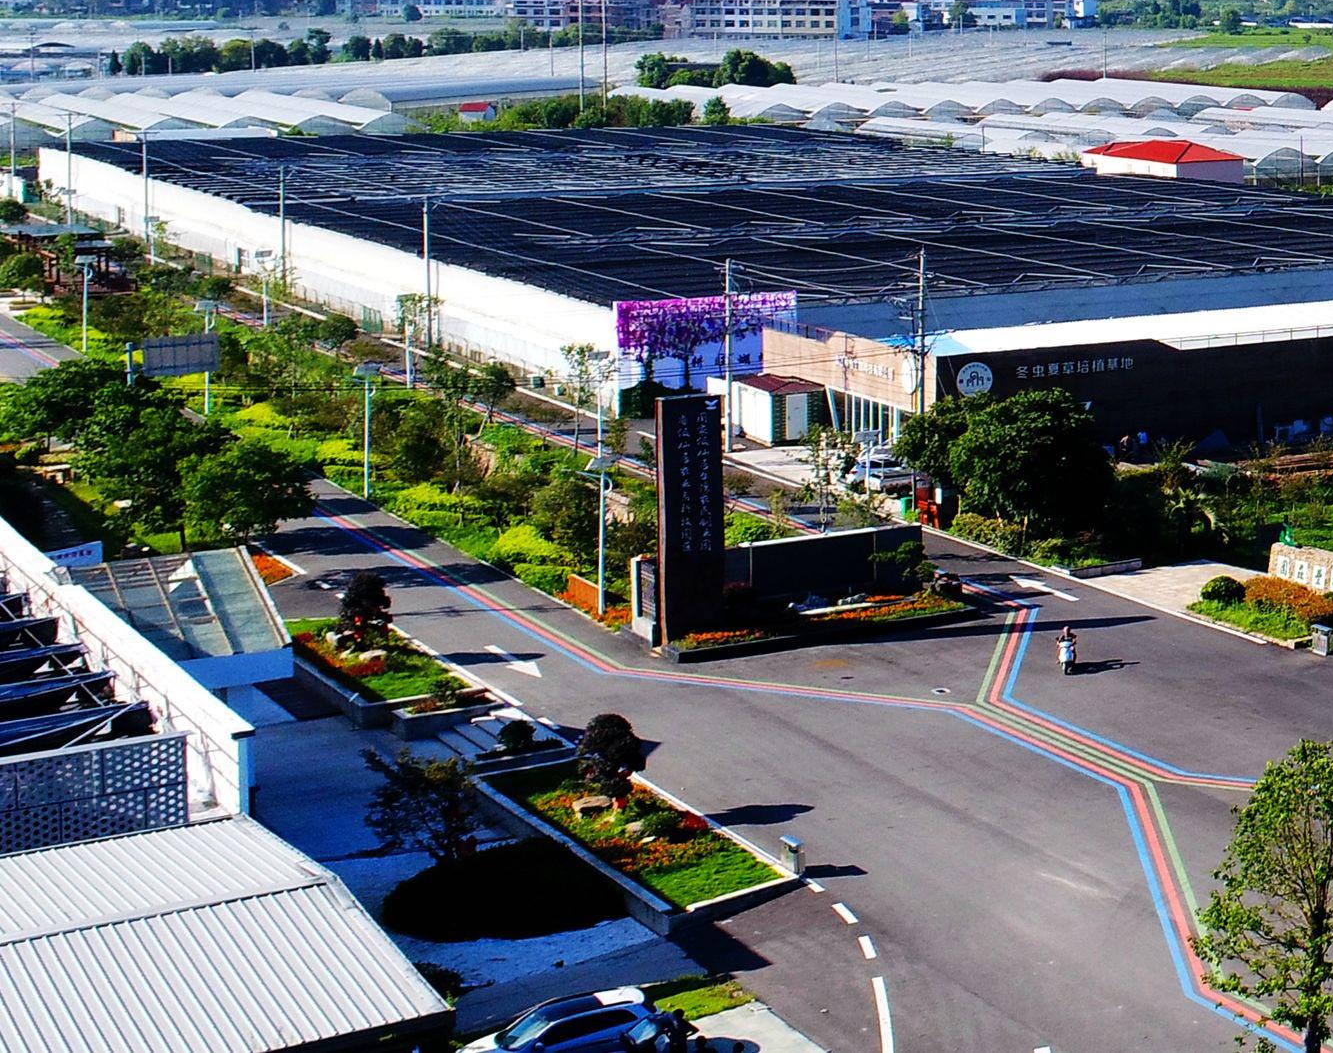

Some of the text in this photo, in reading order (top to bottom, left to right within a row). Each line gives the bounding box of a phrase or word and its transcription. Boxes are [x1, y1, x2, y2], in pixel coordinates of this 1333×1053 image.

[1015, 357, 1135, 379] 冬虫夏草培植基地
